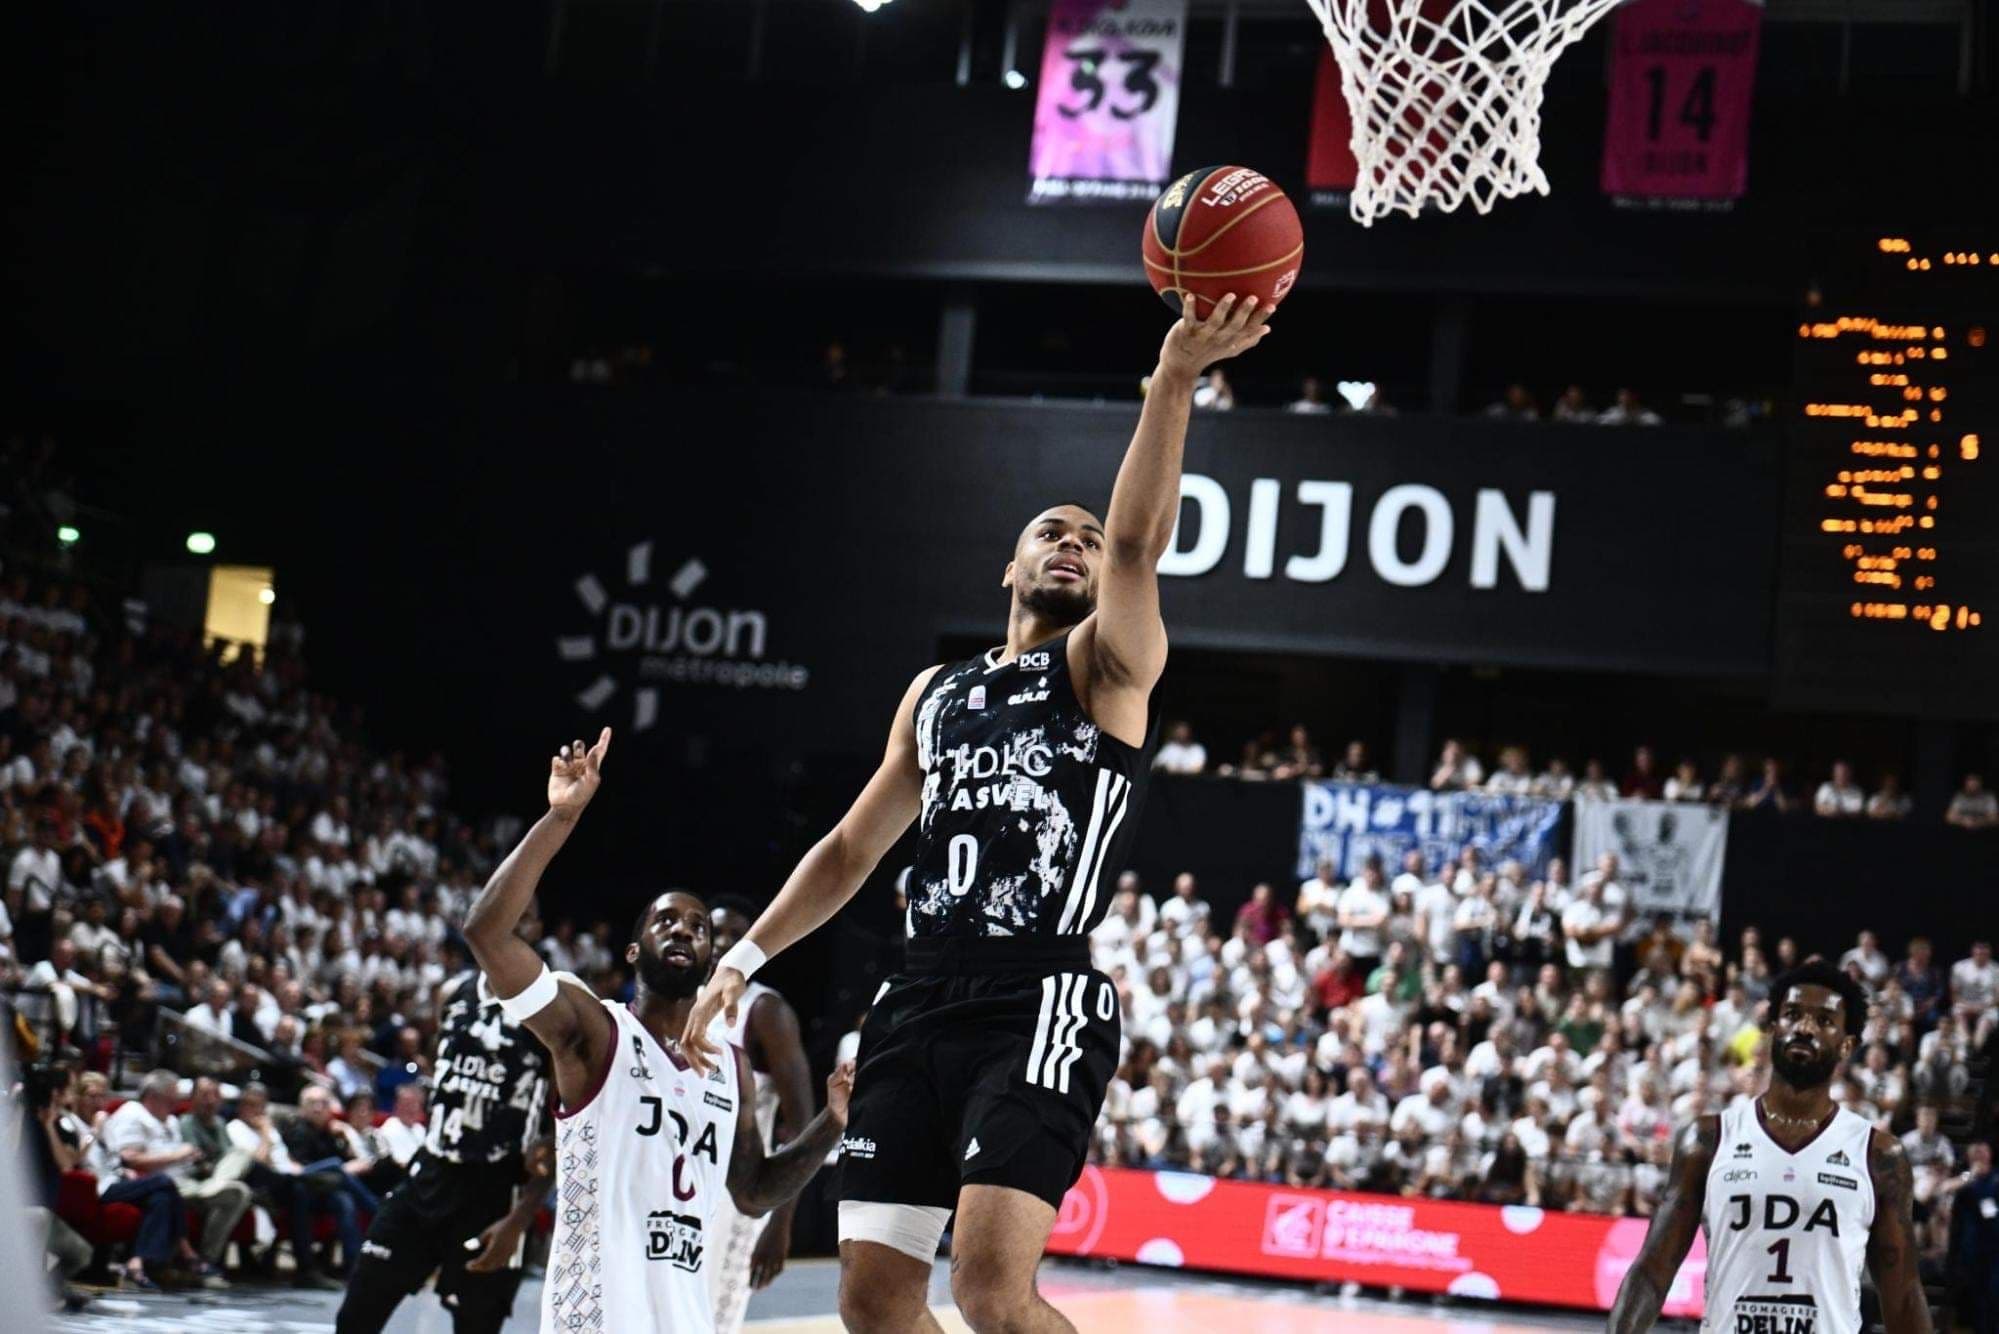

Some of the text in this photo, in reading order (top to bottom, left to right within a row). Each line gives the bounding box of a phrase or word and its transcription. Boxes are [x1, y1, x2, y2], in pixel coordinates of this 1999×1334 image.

[1056, 49, 1160, 120] 33
[1645, 65, 1717, 142] 14
[1156, 473, 1556, 592] DIJON
[1019, 652, 1050, 668] DCB
[951, 783, 1049, 812] ASVEL
[948, 833, 979, 897] 0
[1096, 982, 1115, 1022] 0
[1729, 1194, 1840, 1238] JDA
[1766, 1238, 1794, 1284] 1
